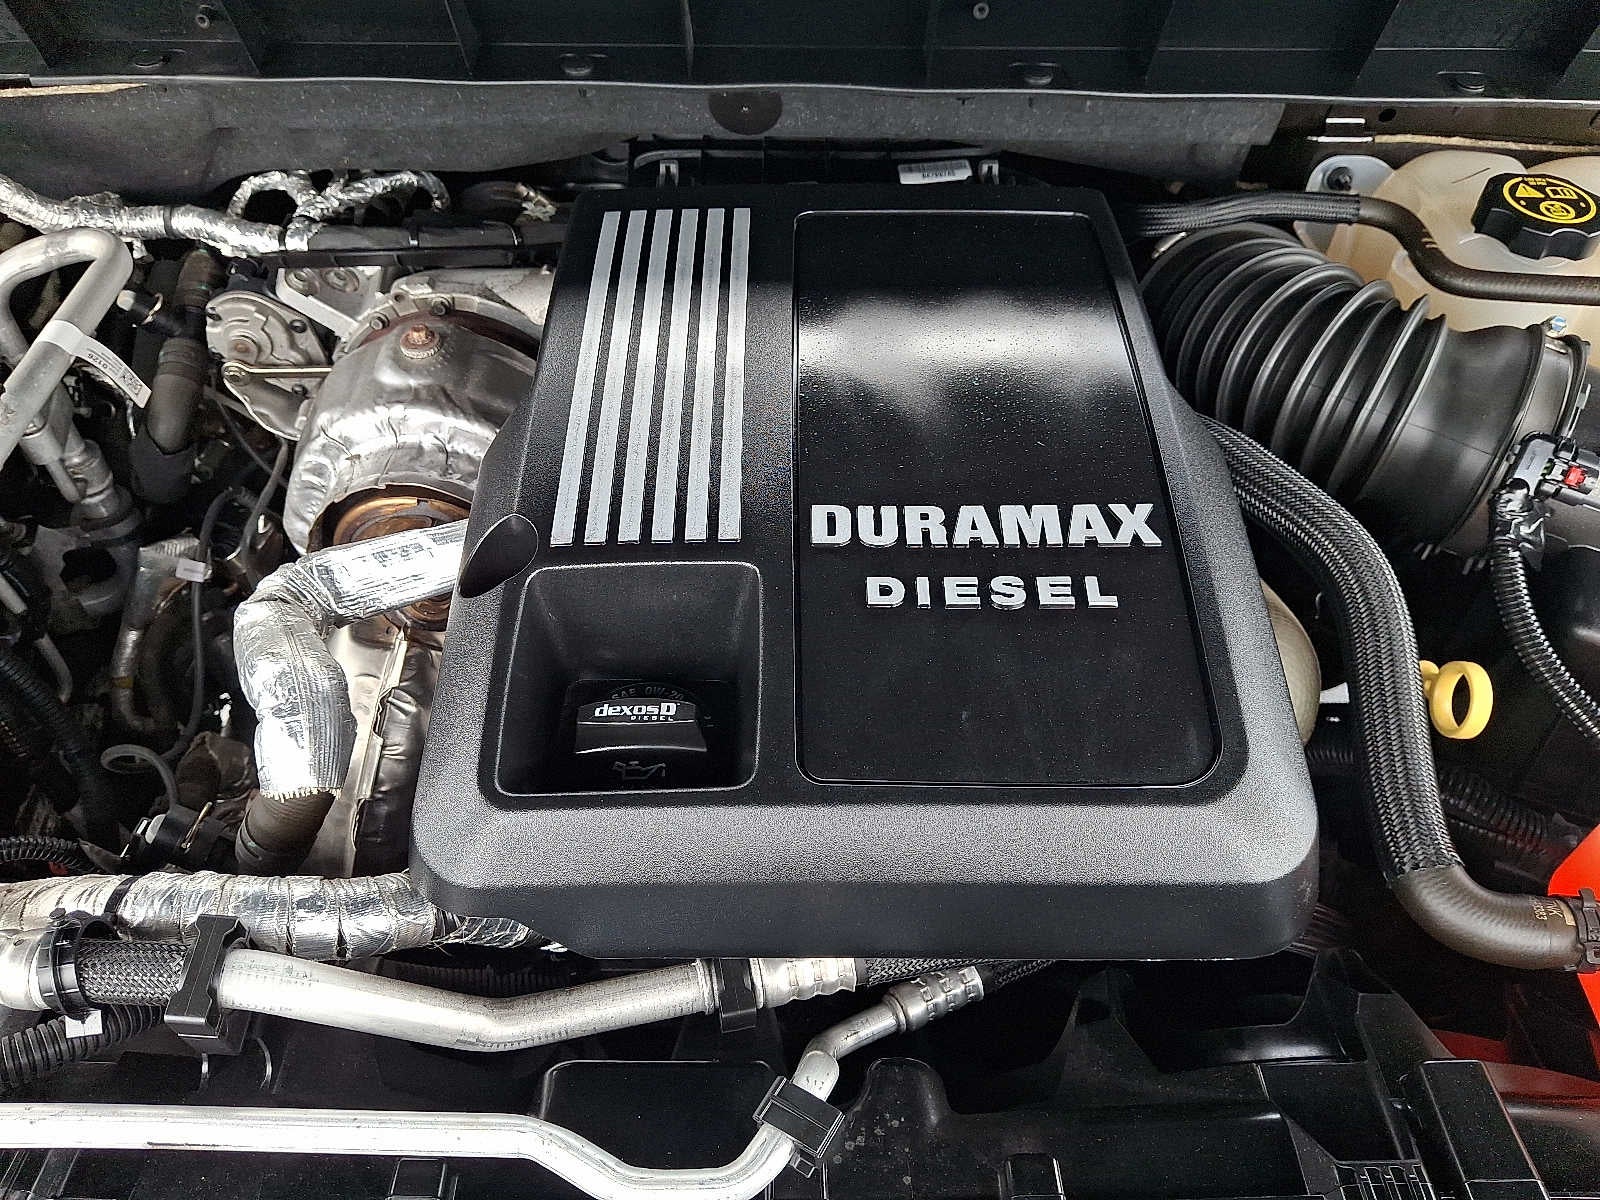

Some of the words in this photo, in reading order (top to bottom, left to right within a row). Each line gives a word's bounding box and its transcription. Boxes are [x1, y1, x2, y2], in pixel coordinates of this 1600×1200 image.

[810, 502, 1163, 549] DURAMAX
[865, 575, 1120, 610] DIESEL
[594, 702, 677, 718] dexosD
